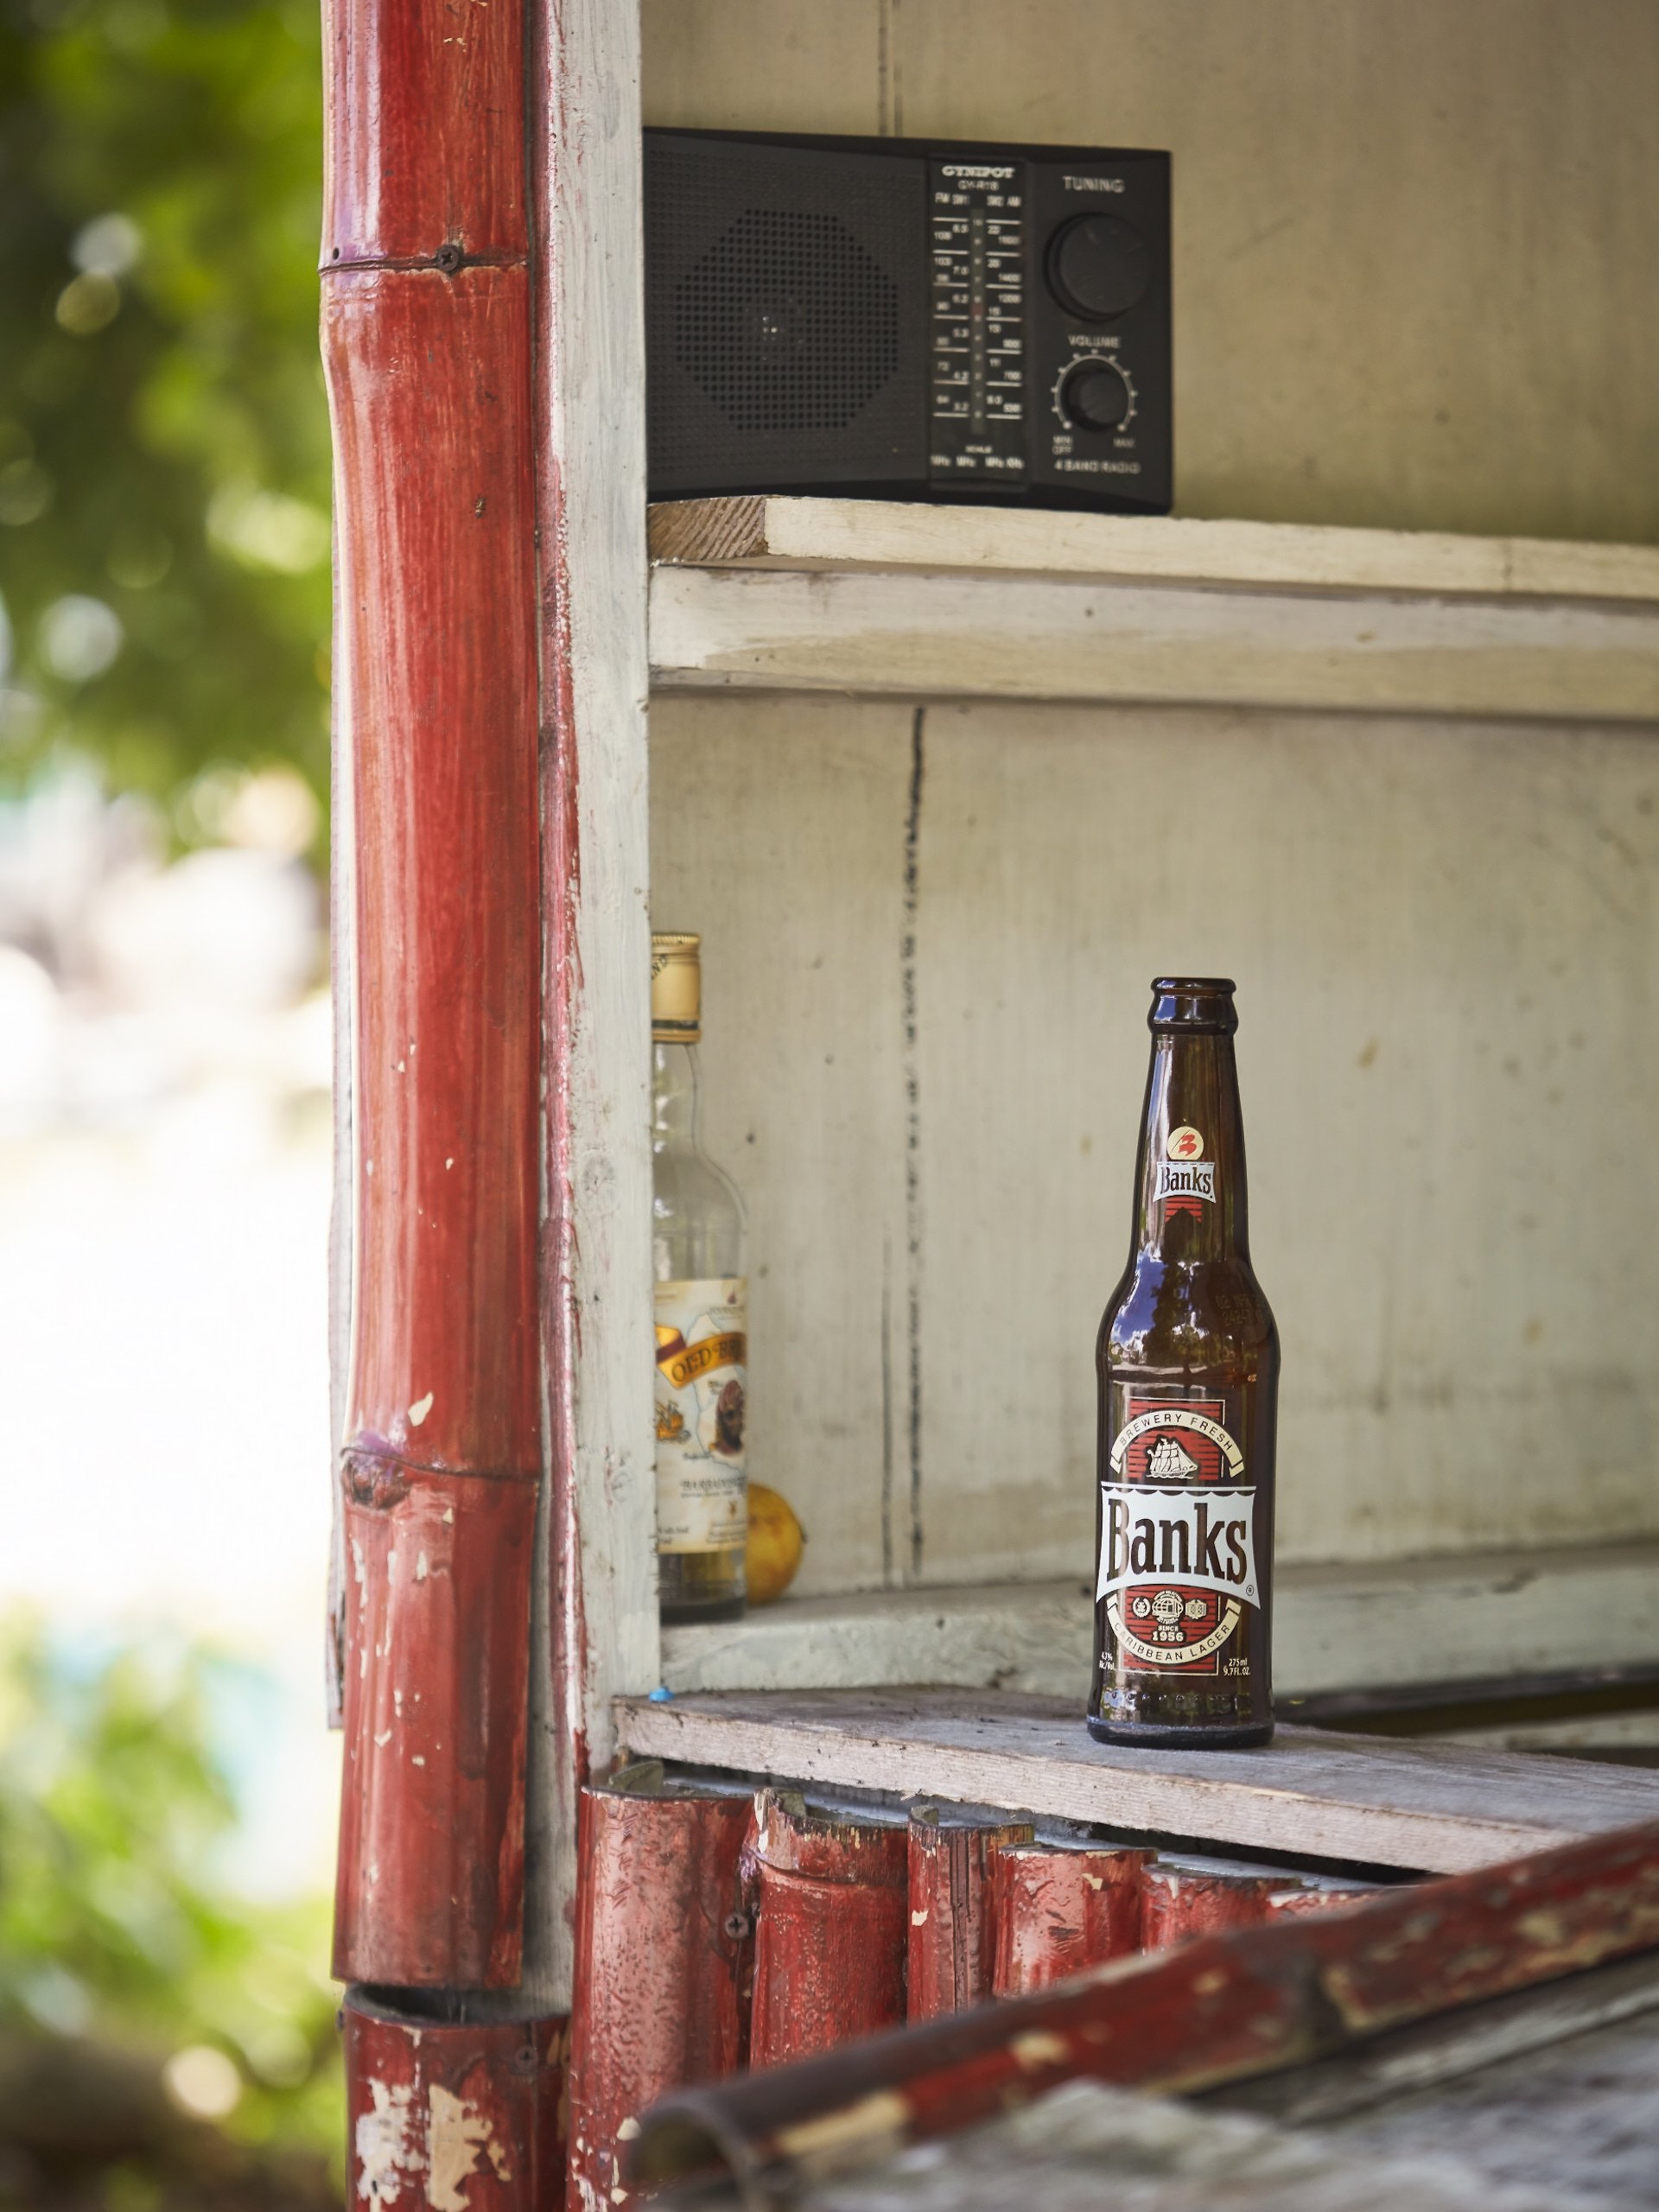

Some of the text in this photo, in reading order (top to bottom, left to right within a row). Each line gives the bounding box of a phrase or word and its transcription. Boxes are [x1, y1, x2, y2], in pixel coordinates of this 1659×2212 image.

[1062, 175, 1125, 194] TUNING
[935, 192, 950, 203] FM
[1007, 196, 1021, 207] AM
[1067, 335, 1121, 348] VOLUME
[1054, 459, 1141, 474] 4 BAND RADIO
[1160, 1166, 1211, 1194] Banks
[1120, 1414, 1233, 1451] BREWERY FRESH
[1107, 1498, 1248, 1586] Banks
[1115, 1623, 1230, 1662] CARIBBEAN LAGER
[1152, 1631, 1184, 1642] 1956
